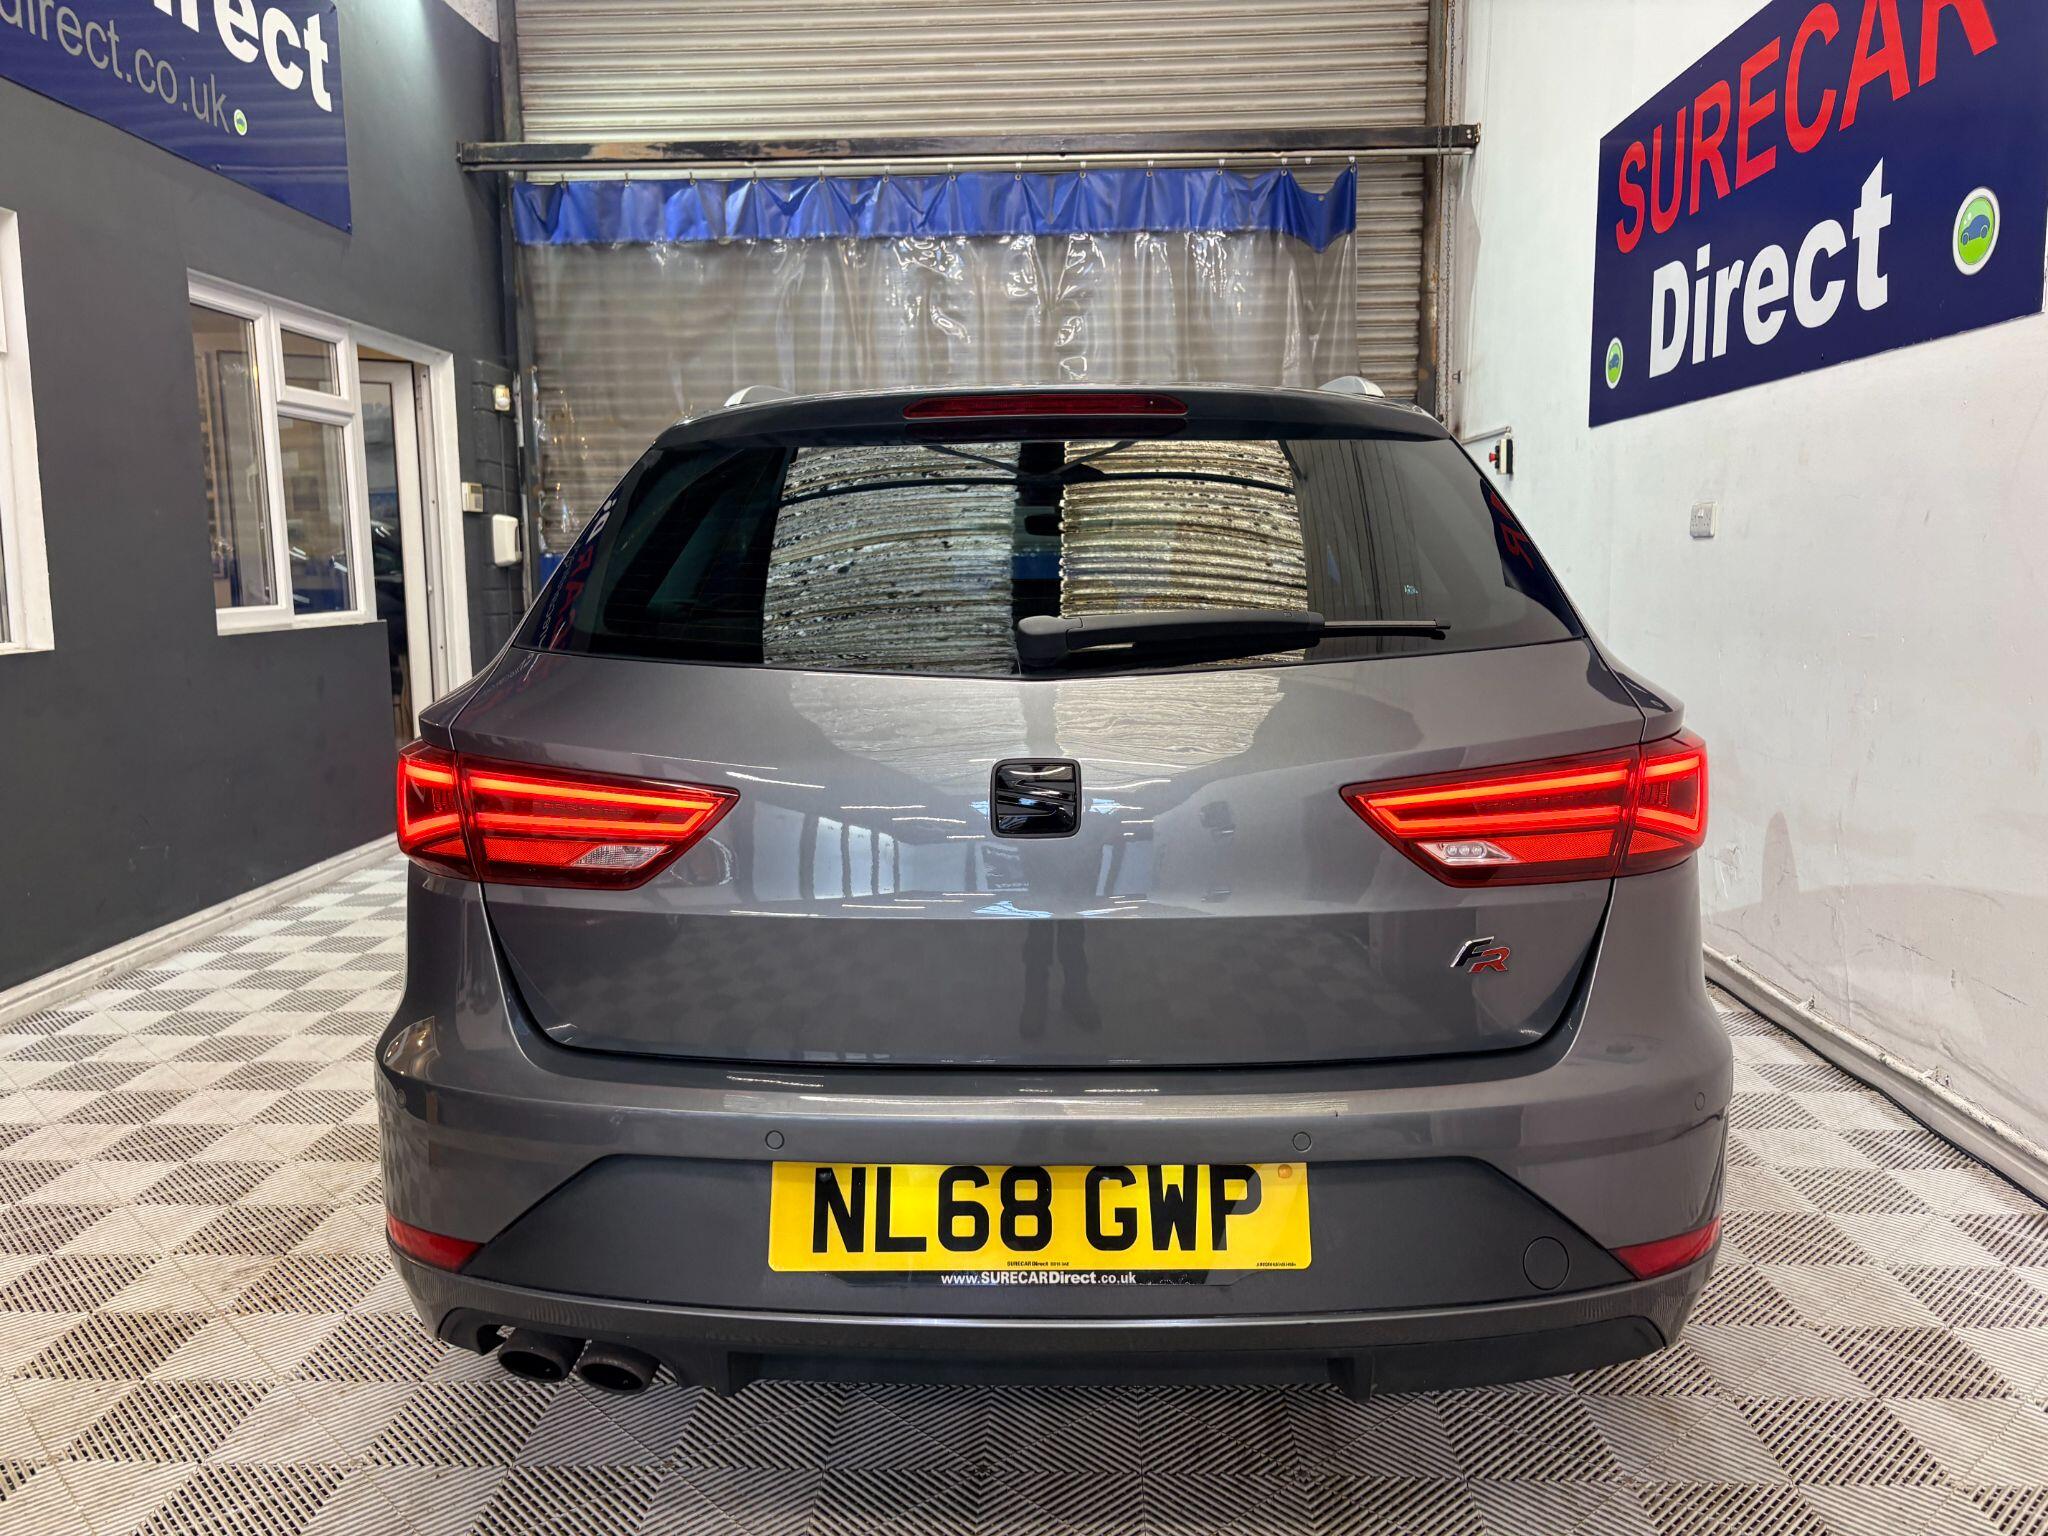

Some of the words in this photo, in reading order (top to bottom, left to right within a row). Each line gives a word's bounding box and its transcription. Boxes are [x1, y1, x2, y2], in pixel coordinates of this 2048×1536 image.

[1649, 156, 1892, 378] Direct
[1449, 936, 1511, 973] FR
[812, 1165, 1052, 1253] NL68
[1085, 1164, 1262, 1252] GWP
[941, 1271, 1137, 1285] www.SURECARDirect.co.uk
